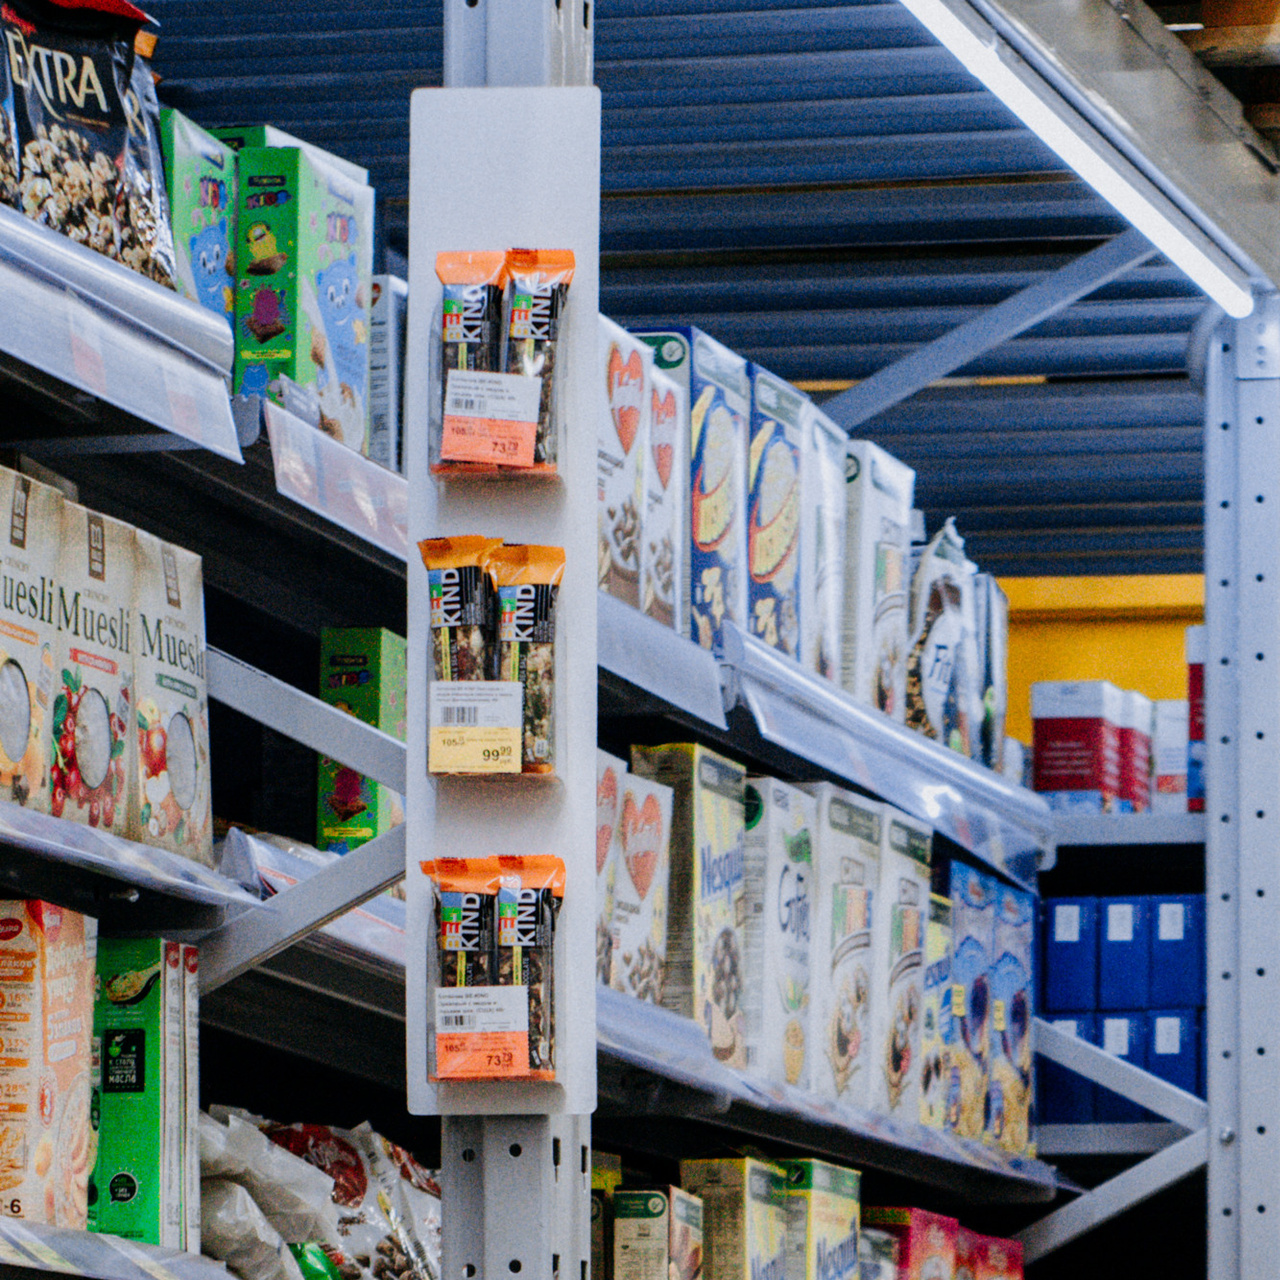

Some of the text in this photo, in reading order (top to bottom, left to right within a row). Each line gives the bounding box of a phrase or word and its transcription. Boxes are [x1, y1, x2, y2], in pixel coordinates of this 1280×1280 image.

[5, 28, 110, 122] EXTRA
[2, 575, 54, 625] uesli
[57, 586, 131, 654] Muesli
[441, 568, 462, 626] KIND
[514, 584, 536, 641] KIND
[461, 892, 481, 951] KIND
